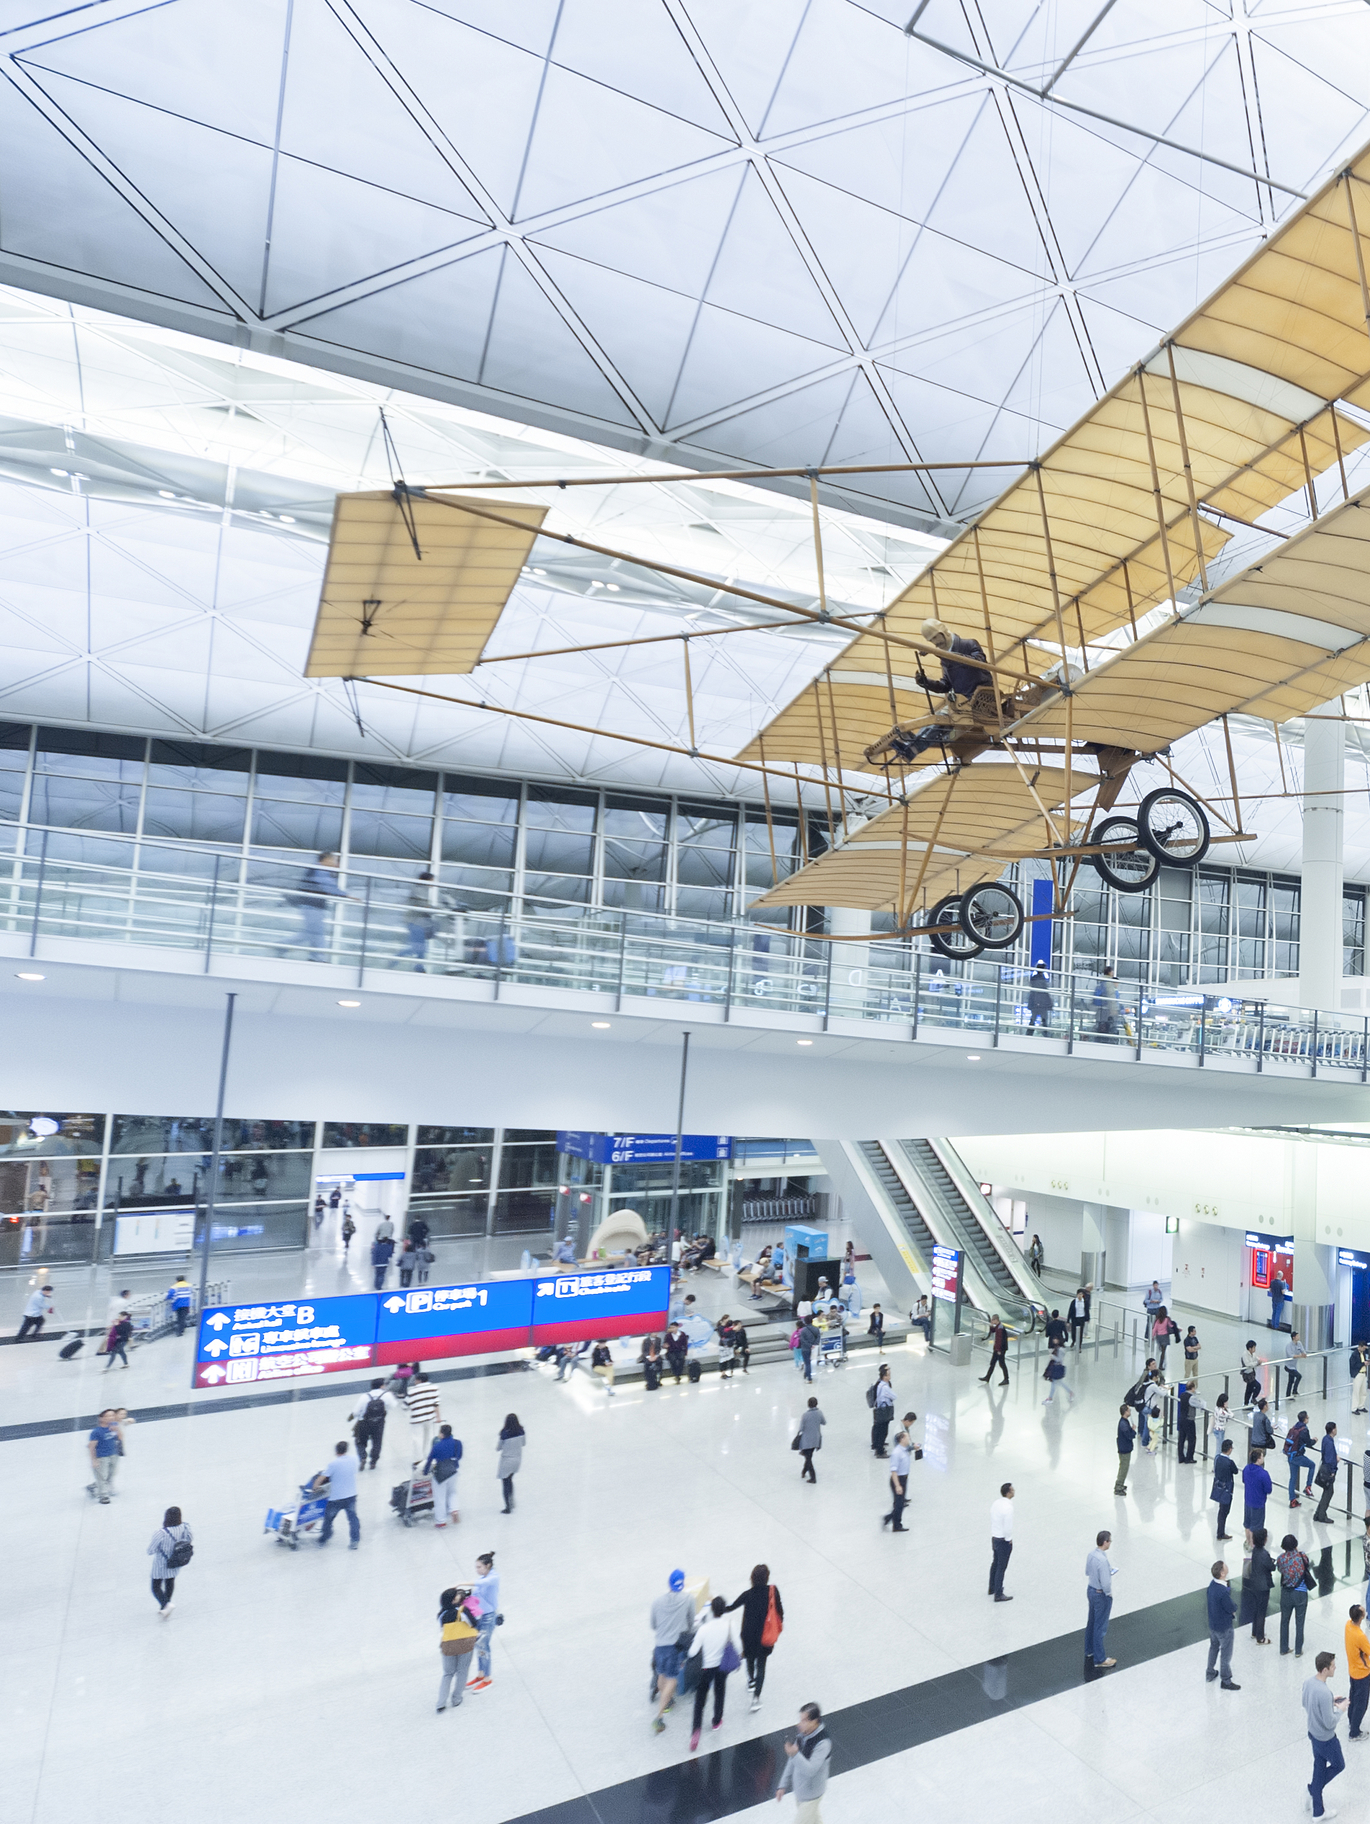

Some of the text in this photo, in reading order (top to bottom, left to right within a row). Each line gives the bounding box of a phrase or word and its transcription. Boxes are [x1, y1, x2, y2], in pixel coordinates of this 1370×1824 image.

[613, 1137, 636, 1148] 7/F
[612, 1150, 634, 1162] 6/F
[479, 1290, 488, 1306] 1
[296, 1306, 315, 1325] B
